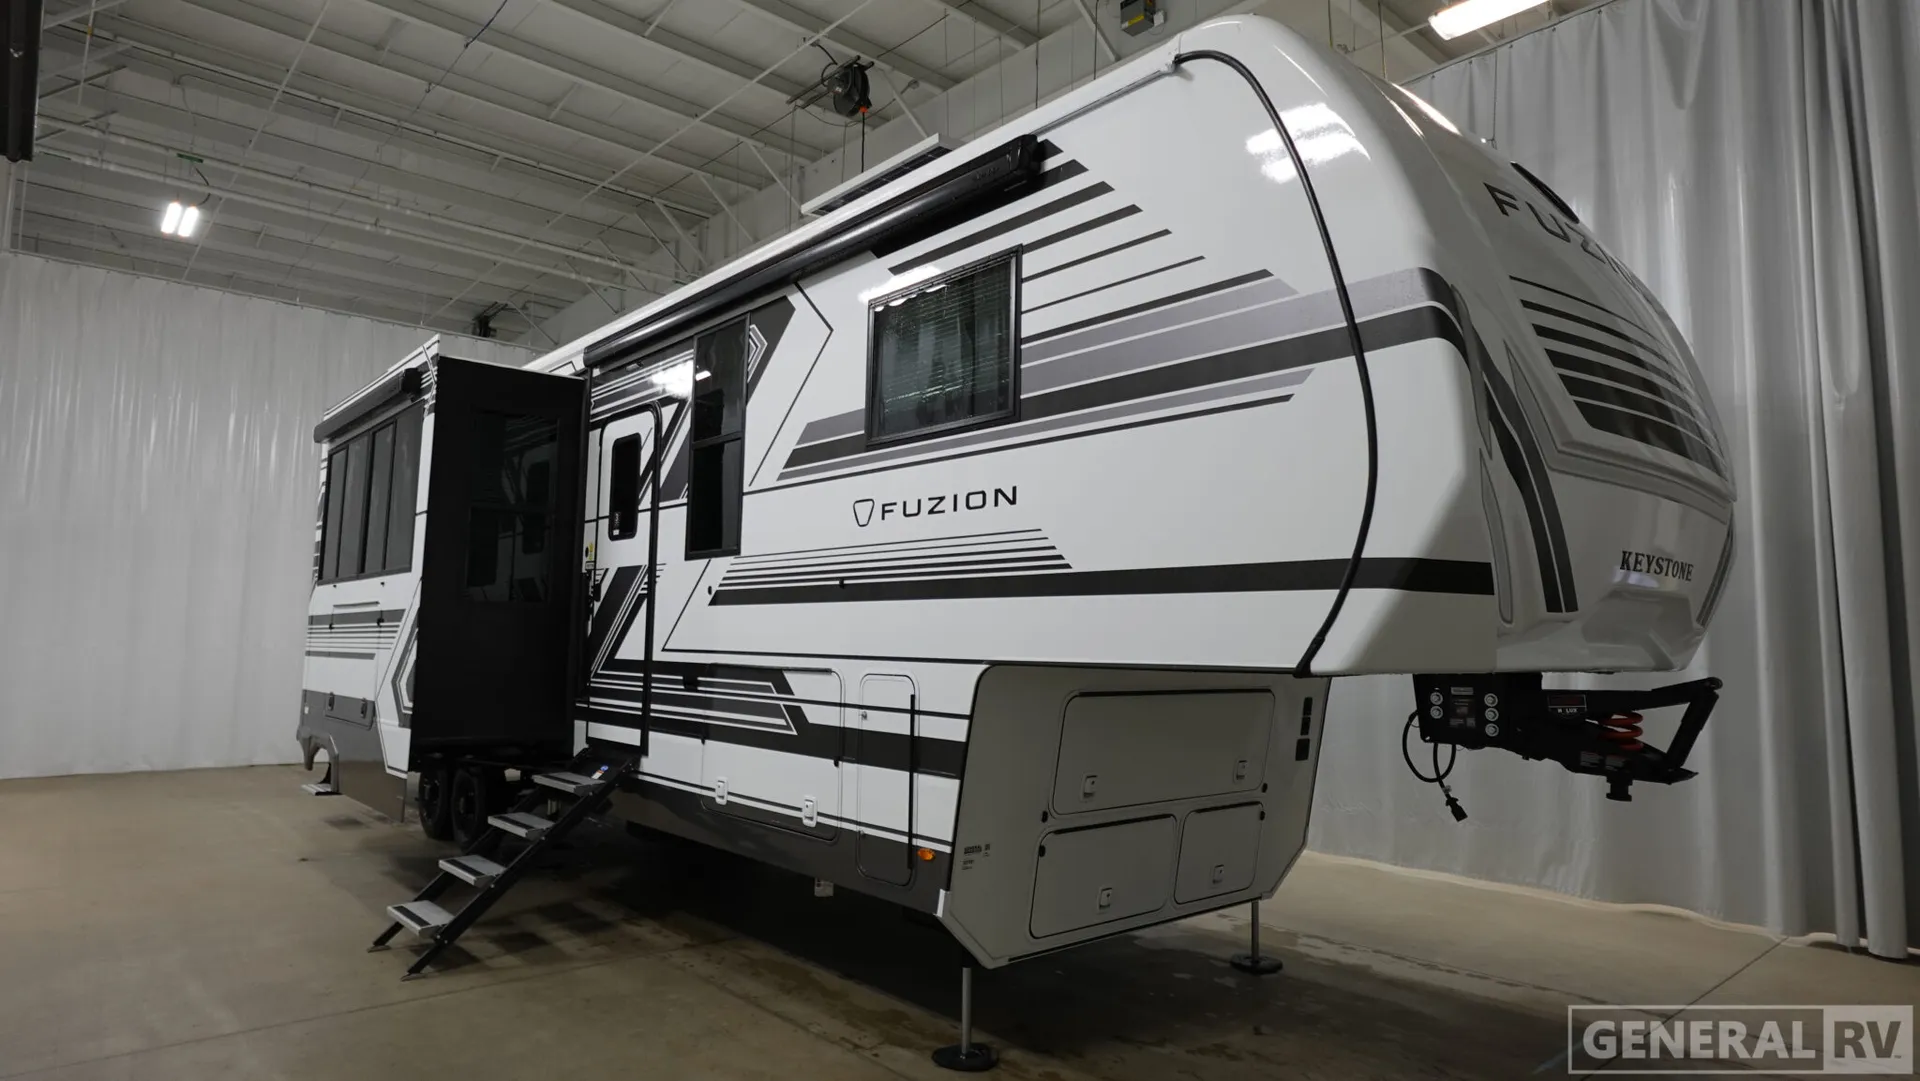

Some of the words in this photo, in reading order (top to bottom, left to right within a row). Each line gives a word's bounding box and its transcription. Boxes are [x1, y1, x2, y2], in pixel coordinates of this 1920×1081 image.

[1483, 181, 1642, 294] FUZI
[882, 486, 1017, 521] FUZION
[1619, 551, 1694, 582] KEYSTONE
